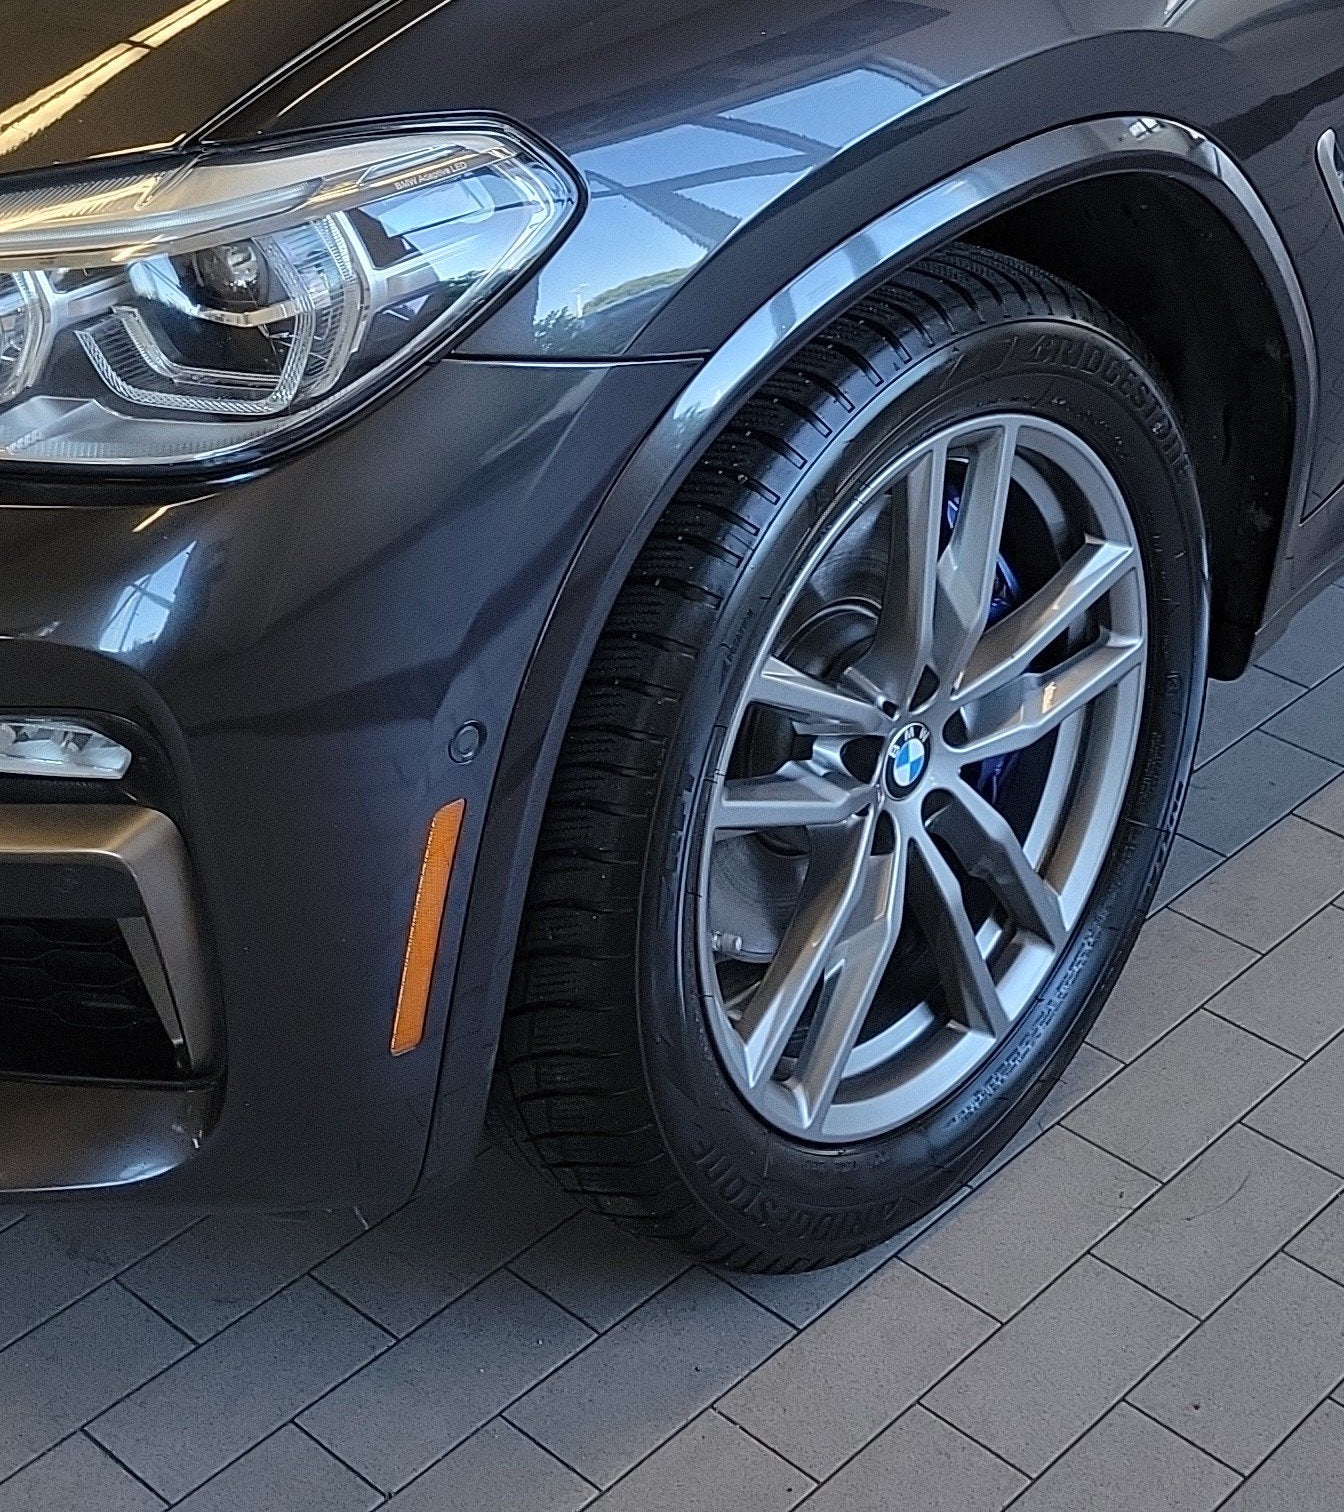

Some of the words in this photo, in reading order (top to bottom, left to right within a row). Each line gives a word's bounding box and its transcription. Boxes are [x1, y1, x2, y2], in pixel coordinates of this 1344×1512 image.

[394, 176, 418, 190] BMW
[450, 161, 468, 173] LED
[888, 726, 931, 759] BMW
